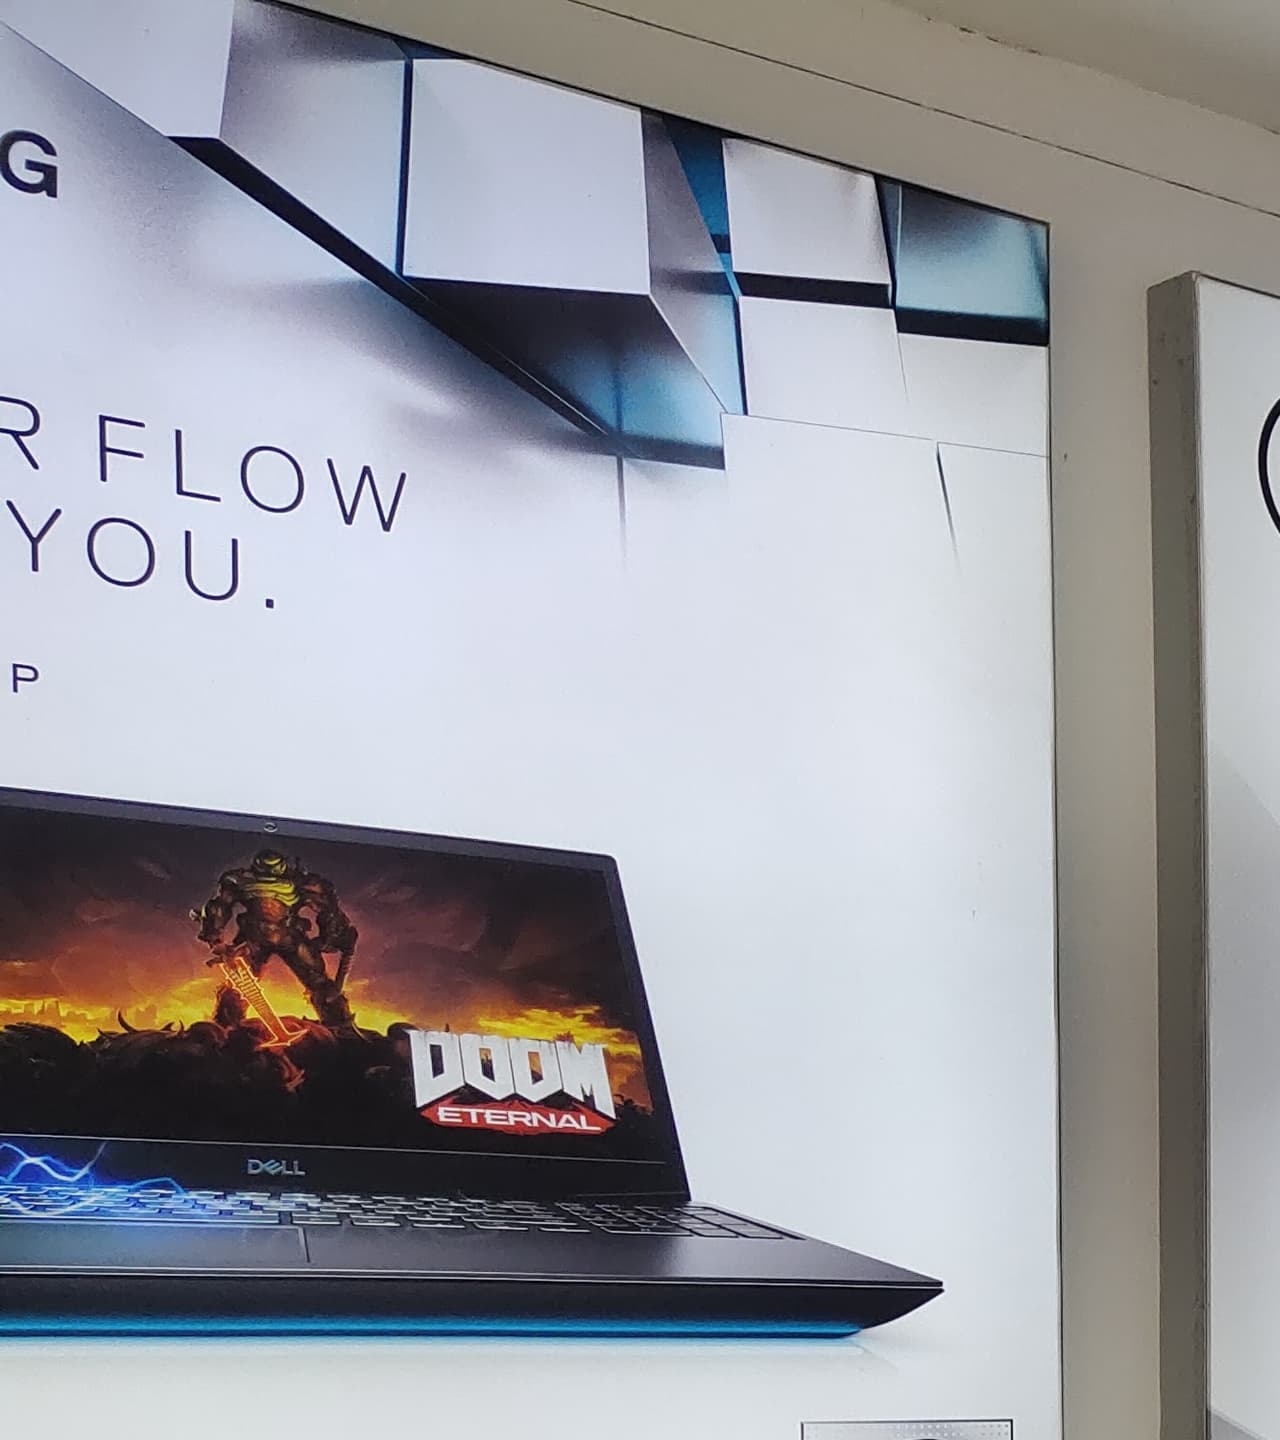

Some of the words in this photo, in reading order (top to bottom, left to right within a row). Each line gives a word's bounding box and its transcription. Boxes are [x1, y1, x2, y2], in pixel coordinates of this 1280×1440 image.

[98, 415, 406, 532] FLOW
[6, 500, 275, 608] YOU.
[408, 1029, 616, 1120] DOOM
[437, 1106, 601, 1131] ETERNAL
[247, 1158, 305, 1176] DELL
